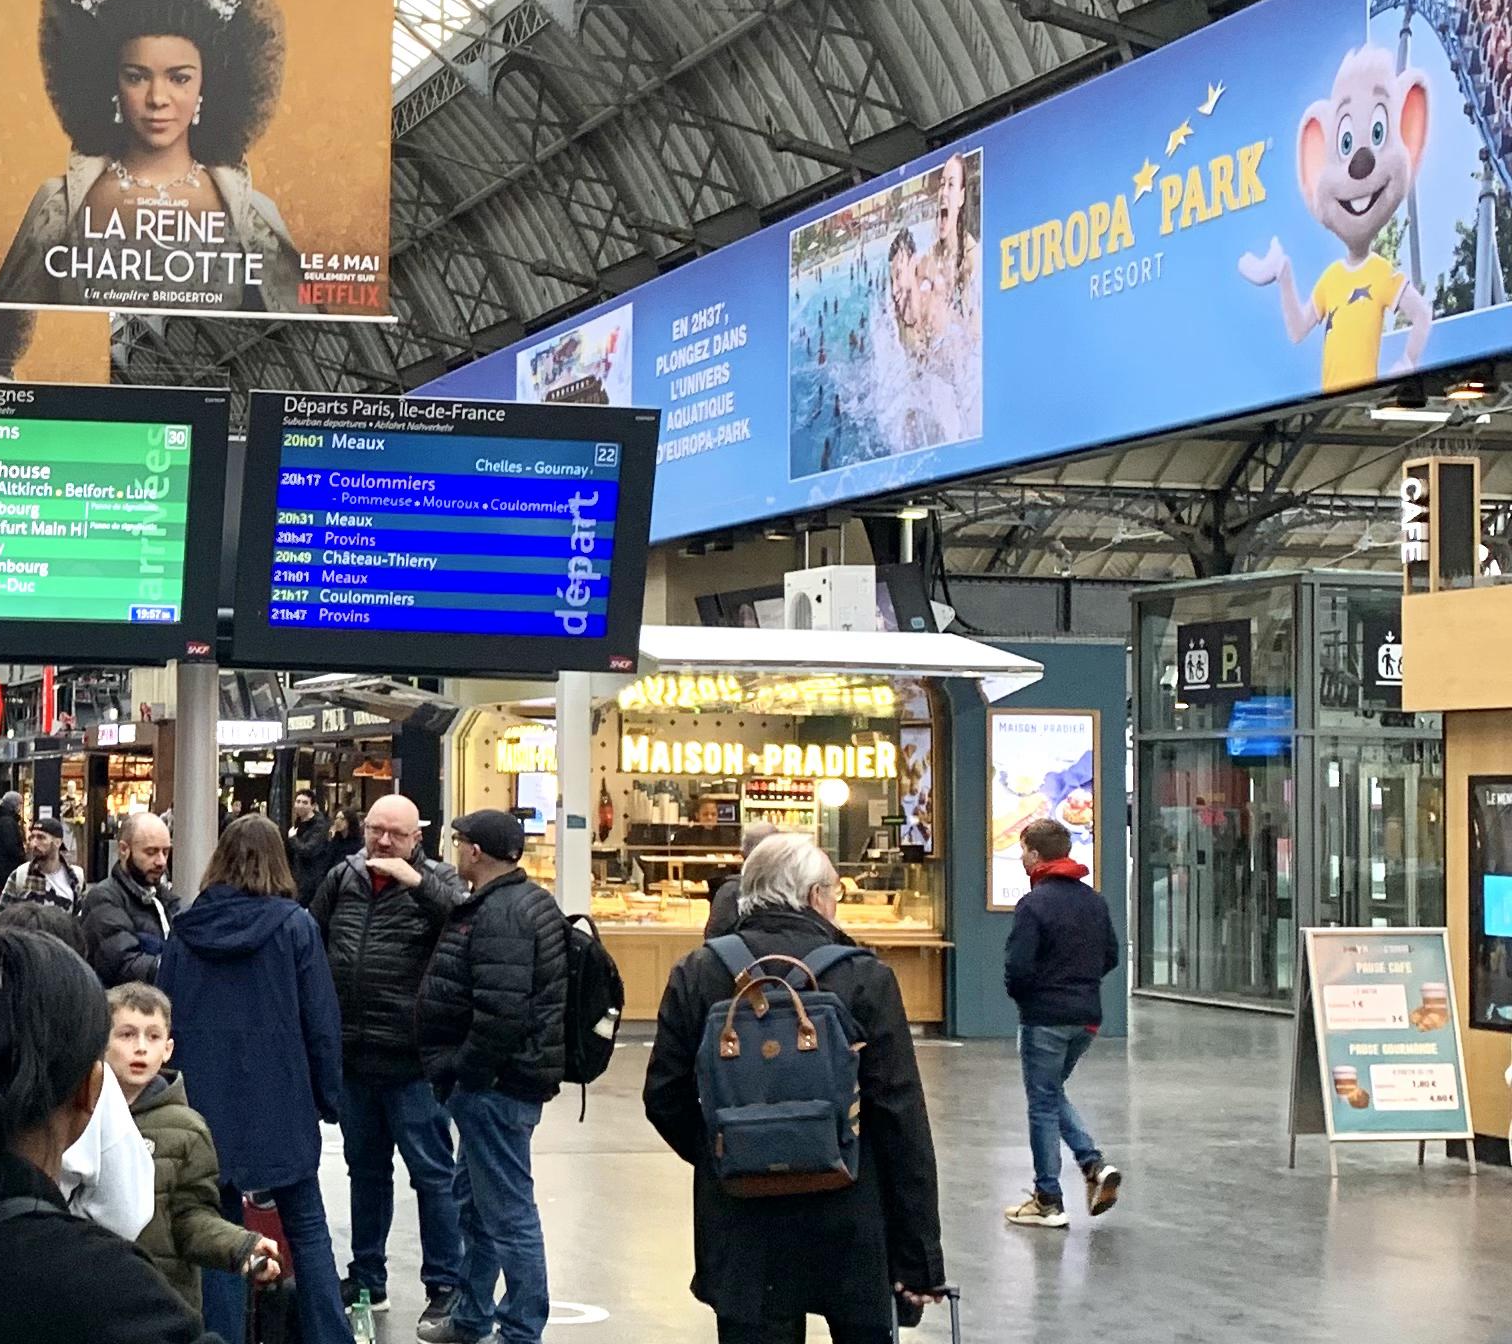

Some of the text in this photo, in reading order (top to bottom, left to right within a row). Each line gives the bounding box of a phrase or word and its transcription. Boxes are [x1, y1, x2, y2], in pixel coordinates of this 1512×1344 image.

[1000, 141, 1266, 290] EUROPA PARK
[85, 206, 225, 250] LA REINE
[45, 245, 263, 285] CHARLOTTE
[300, 253, 379, 271] LE 4 MAI
[304, 272, 376, 282] SEULEMENT SUR
[1090, 252, 1164, 300] RESORT
[84, 288, 222, 304] Un chapitre BRIDGERTON
[298, 283, 380, 307] NETFLIX
[672, 318, 688, 341] EN
[656, 324, 747, 377] PLONGEZ DANS
[670, 362, 730, 401] L'UNIVERS
[284, 397, 505, 421] Départs Paris, Île-de-France
[666, 391, 735, 431] AQUATIQUE
[168, 431, 184, 444] 30
[284, 434, 616, 462] 20h01 Meaux 22
[475, 458, 588, 478] Chelles Gournay
[65, 484, 115, 498] Belfort
[280, 472, 435, 491] 20h17 Coulommiers
[342, 493, 412, 506] Pommeuse
[423, 497, 479, 509] Mouroux
[31, 522, 66, 536] Main
[278, 512, 373, 527] 20h31 Meaux
[1401, 477, 1423, 563] CAFE
[325, 532, 376, 547] Provins
[275, 551, 437, 570] 20h49 Château-Thierry
[555, 491, 601, 635] départ
[274, 570, 368, 584] 21h01 Meaux
[272, 589, 414, 605] 21h17 Coulommiers
[271, 608, 370, 622] 21h47 Provins
[999, 723, 1085, 733] MAISON PRADIER
[621, 735, 897, 778] MAISON PRADIER
